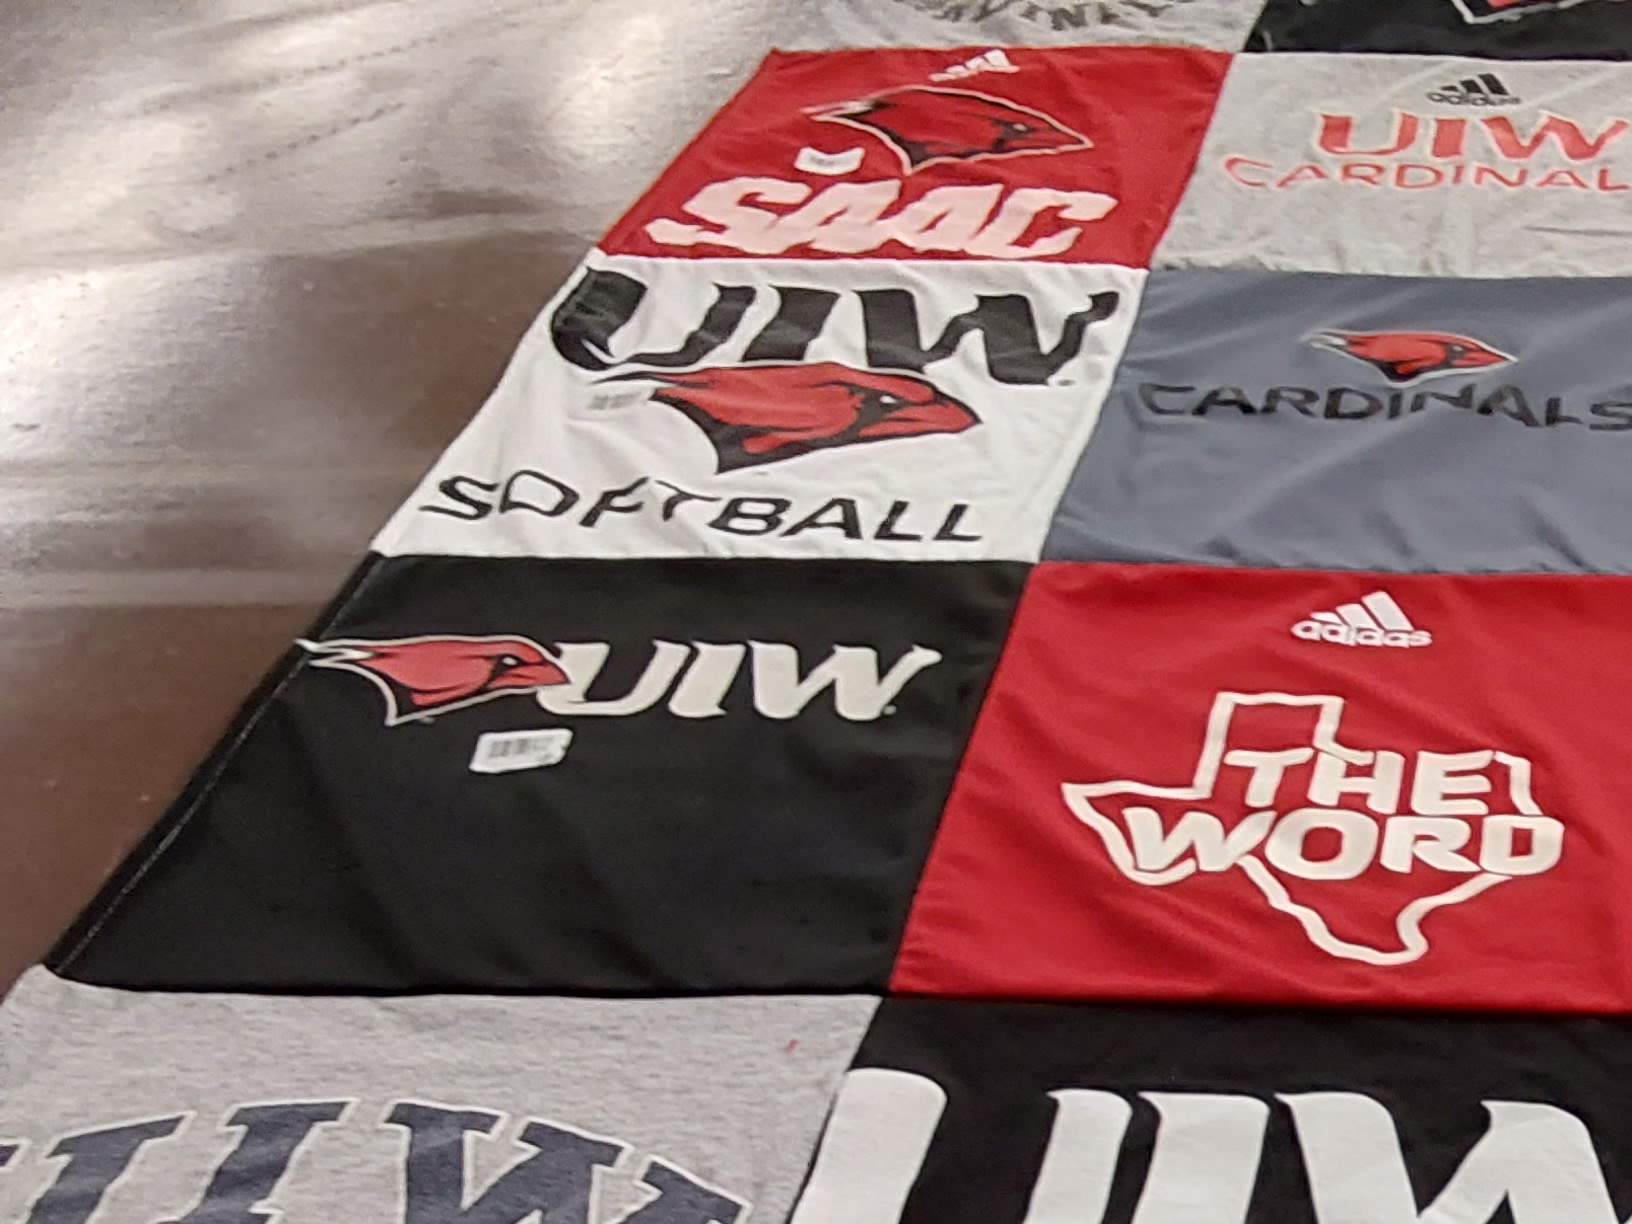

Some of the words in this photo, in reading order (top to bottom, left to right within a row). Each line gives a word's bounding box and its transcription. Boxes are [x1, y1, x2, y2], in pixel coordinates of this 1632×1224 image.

[1316, 110, 1630, 161] UIW
[645, 177, 1119, 259] SAAC
[550, 266, 1120, 386] UIW
[419, 470, 982, 542] SOFTBALL
[1291, 617, 1432, 648] adidas
[537, 640, 942, 721] UIW
[1224, 747, 1495, 816] THE
[1121, 806, 1564, 880] WORD
